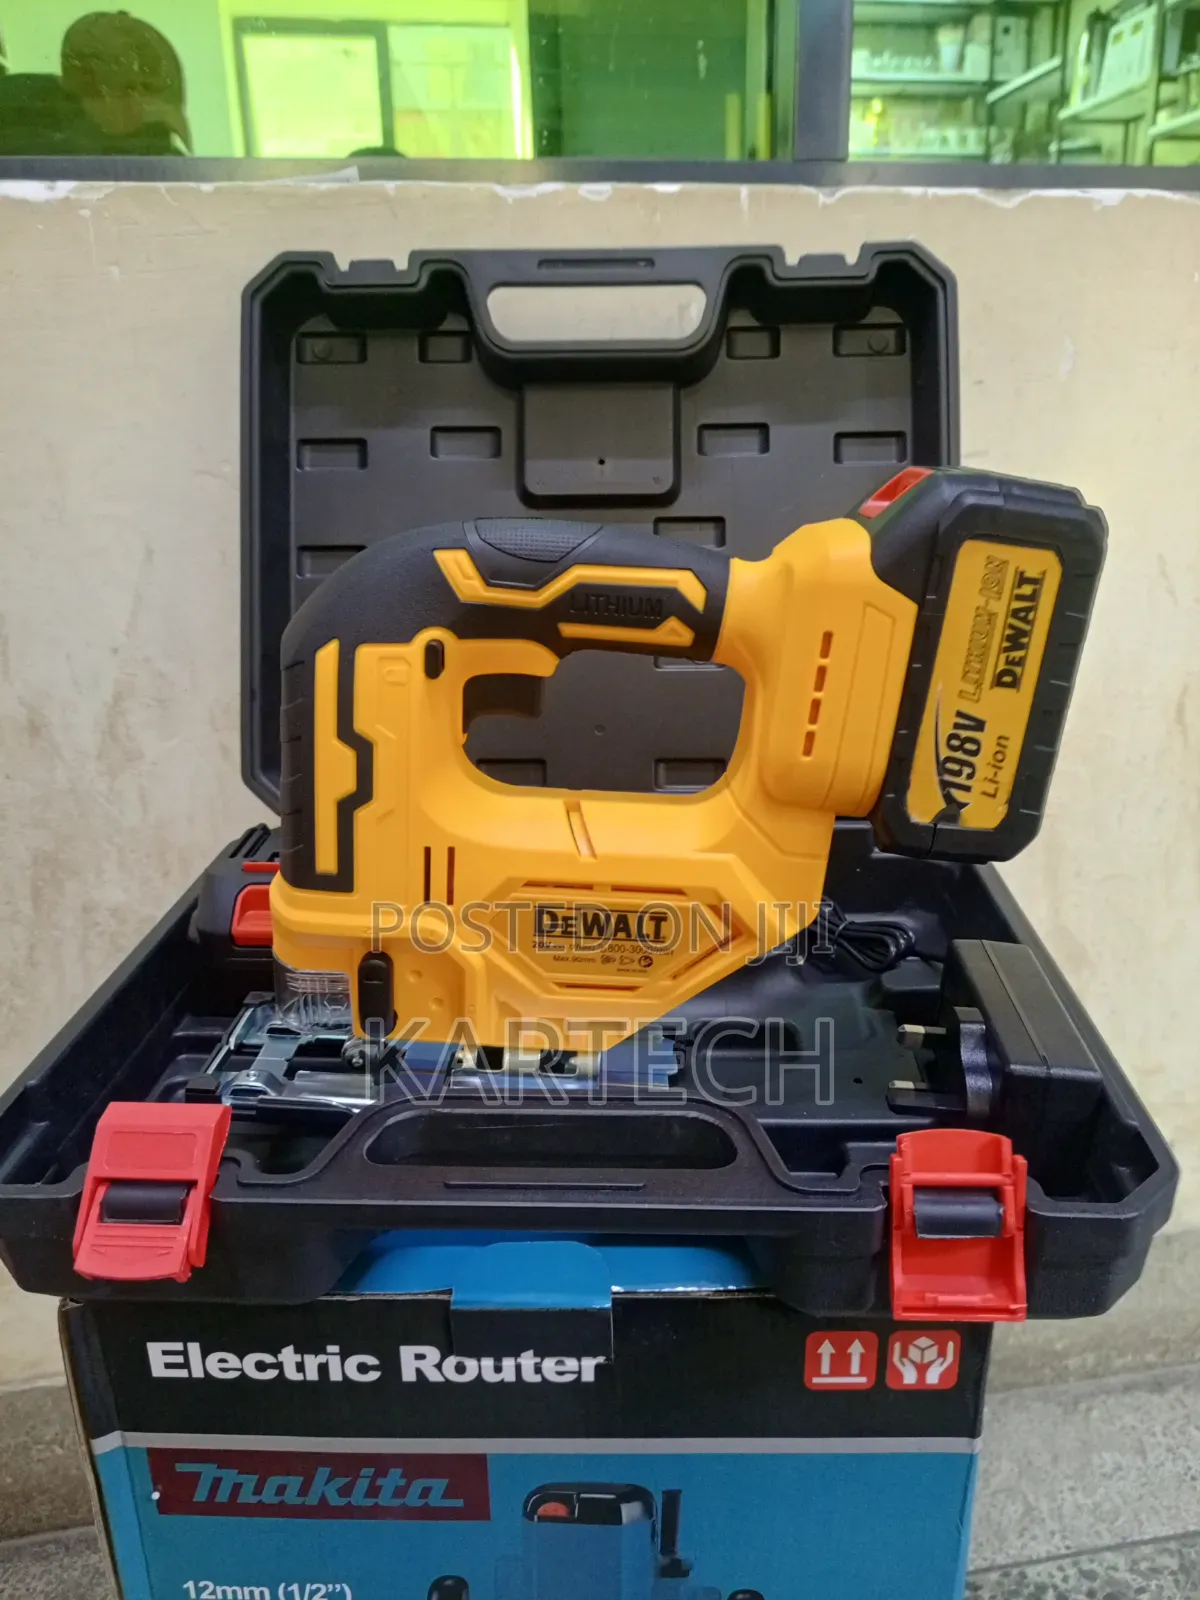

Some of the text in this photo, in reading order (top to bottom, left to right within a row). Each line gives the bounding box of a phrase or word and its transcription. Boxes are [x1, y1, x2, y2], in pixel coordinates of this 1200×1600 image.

[570, 592, 662, 619] LITHIUM
[994, 567, 1043, 690] DEWALT
[941, 709, 986, 793] 198V
[981, 735, 1010, 799] Li-ion
[534, 907, 668, 941] DEWALT
[147, 1341, 605, 1383] Electric Router
[175, 1463, 464, 1508] Makita
[183, 1580, 270, 1600] 12mm
